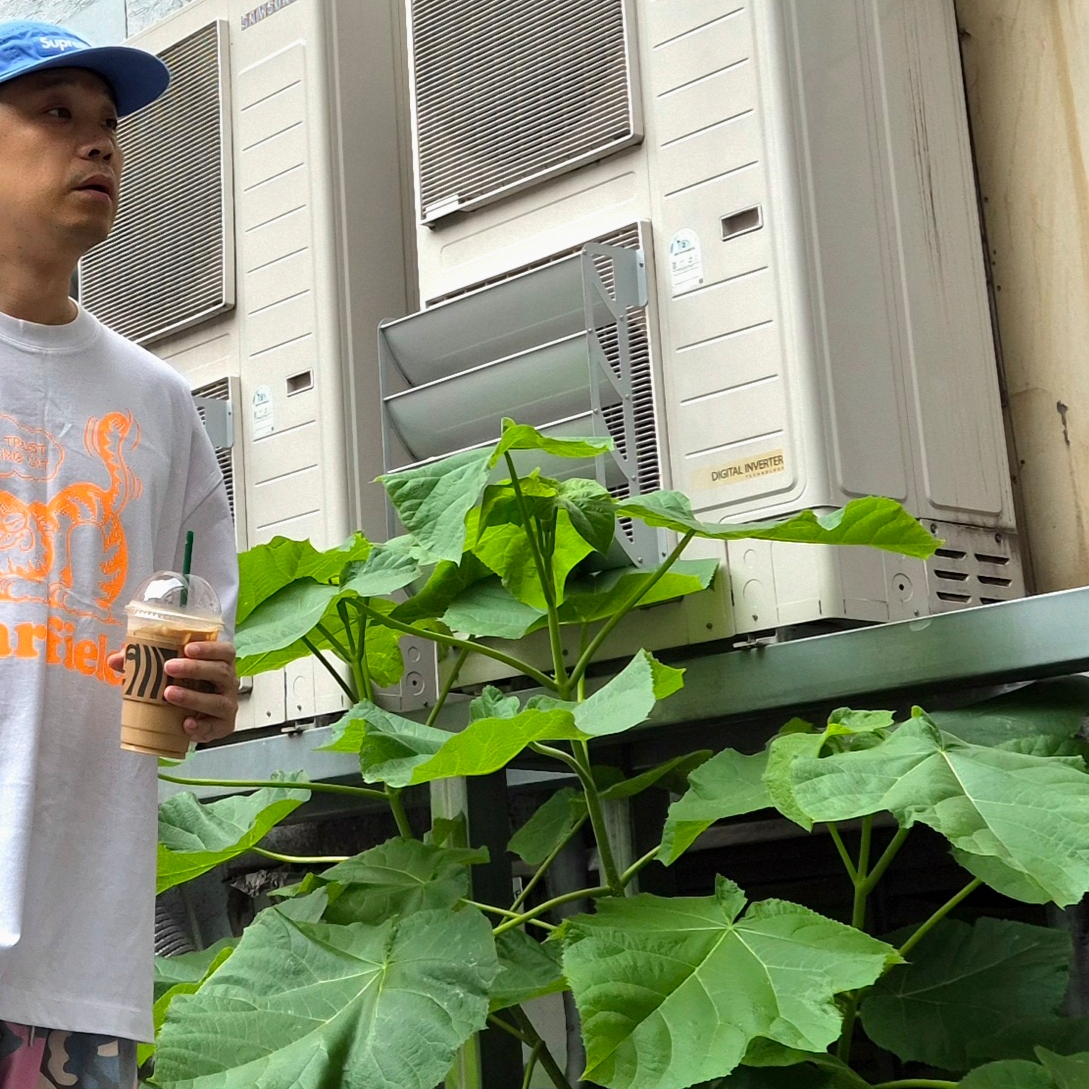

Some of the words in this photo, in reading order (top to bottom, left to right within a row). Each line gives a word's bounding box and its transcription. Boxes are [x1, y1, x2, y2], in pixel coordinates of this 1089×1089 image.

[4, 435, 47, 455] TRUST
[27, 452, 49, 471] CAT
[711, 465, 743, 481] DIGITAL
[744, 454, 784, 473] INVERTER
